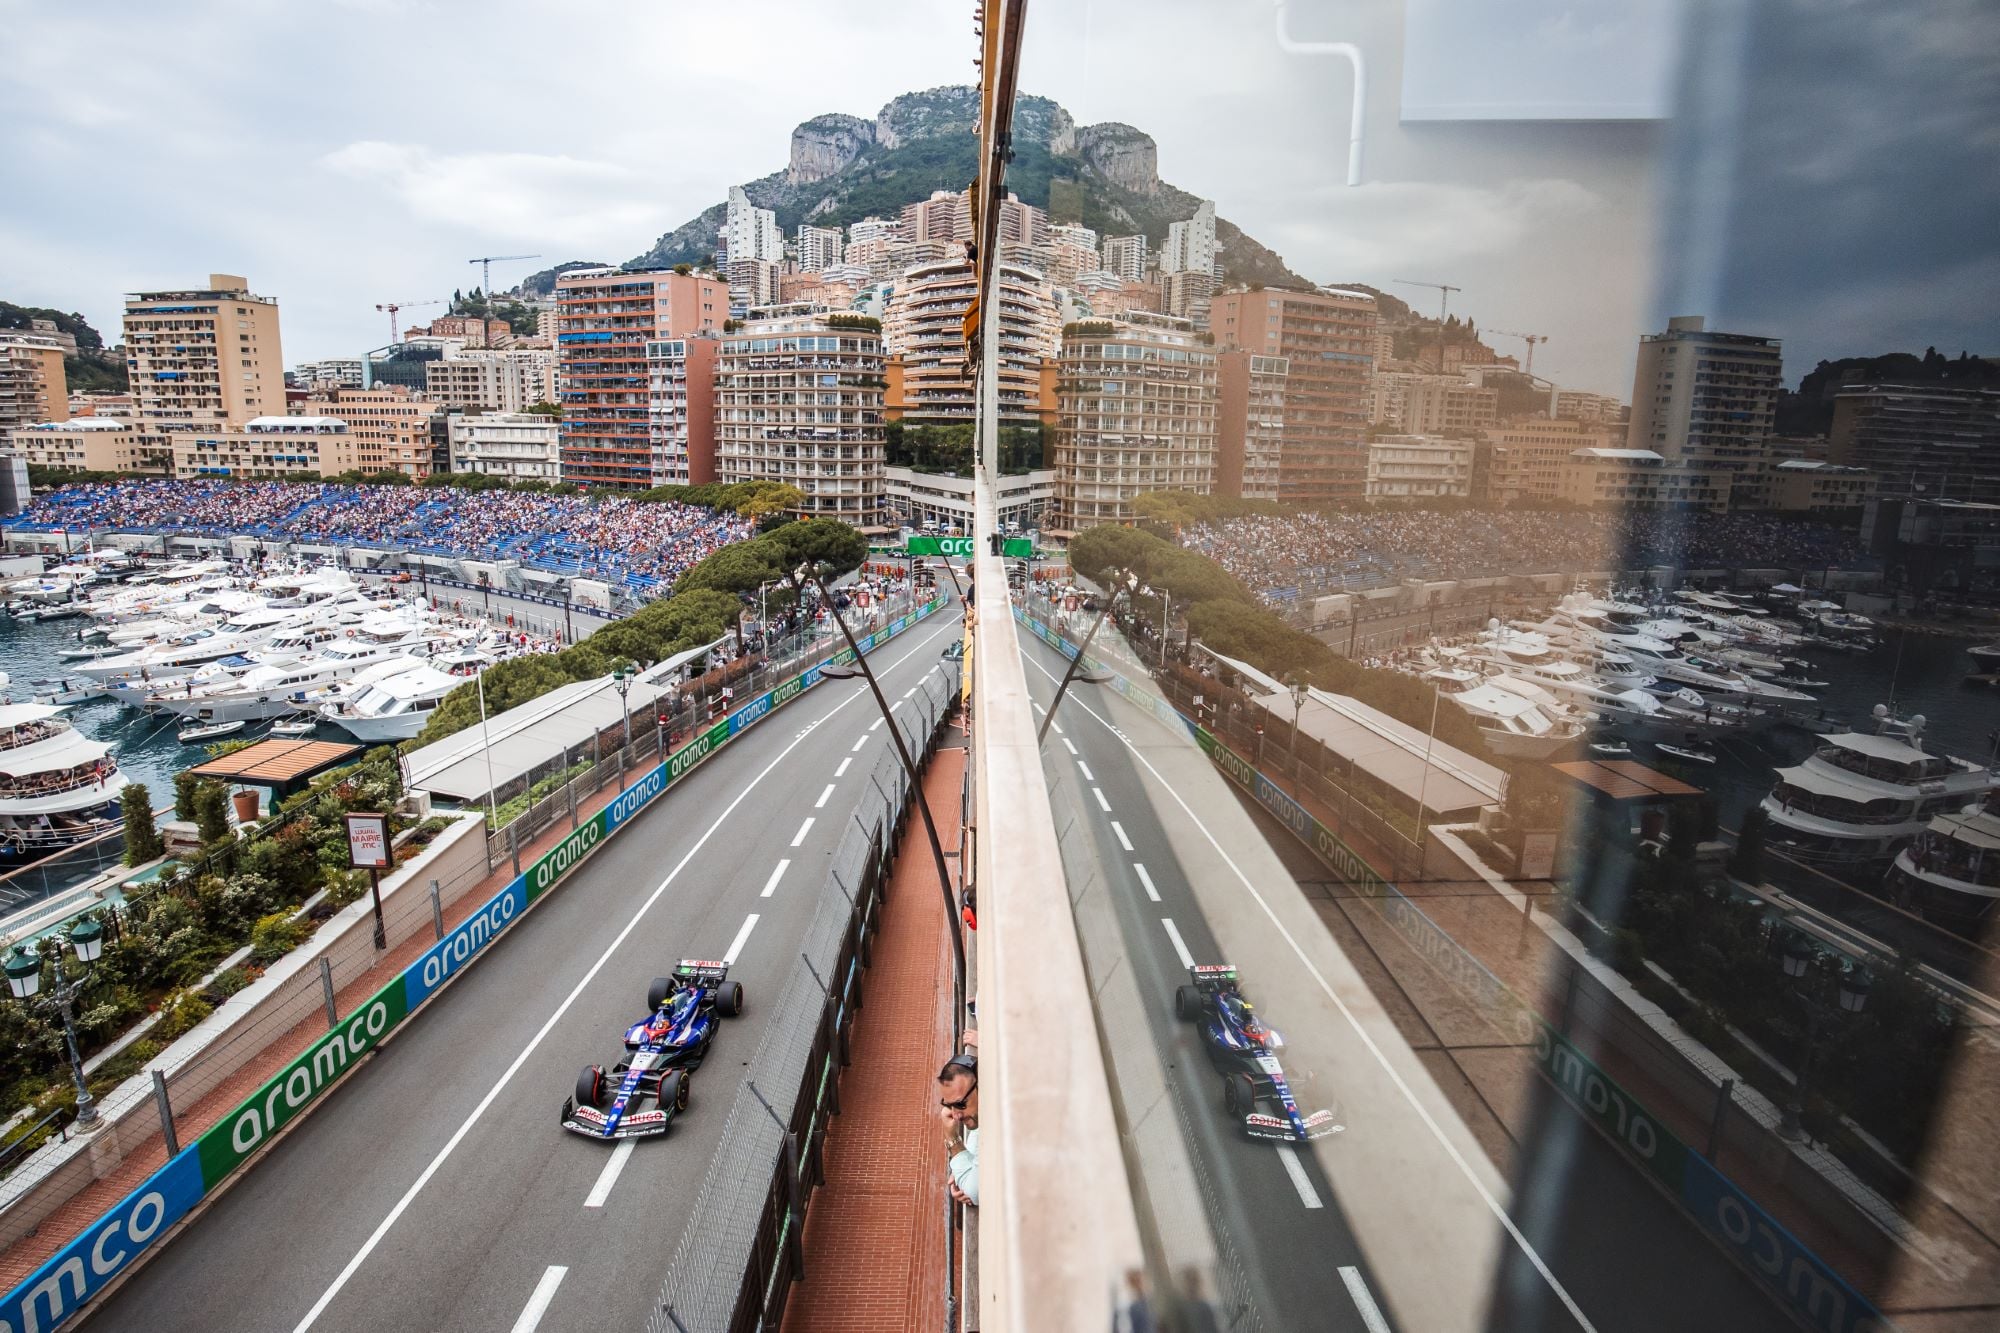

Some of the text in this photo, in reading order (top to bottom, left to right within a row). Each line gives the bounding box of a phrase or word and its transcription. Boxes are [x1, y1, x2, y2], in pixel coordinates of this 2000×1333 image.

[773, 679, 800, 705] aramco
[737, 698, 767, 728] aramco
[672, 737, 709, 777] aramco
[613, 773, 660, 823] aramco
[352, 834, 381, 842] MAIRIE
[537, 822, 599, 888] aramco
[423, 892, 515, 988] aramco
[232, 1001, 387, 1154] aramco
[579, 1107, 602, 1121] HUGO
[629, 1112, 663, 1124] HUGO
[0, 1191, 165, 1333] mco
